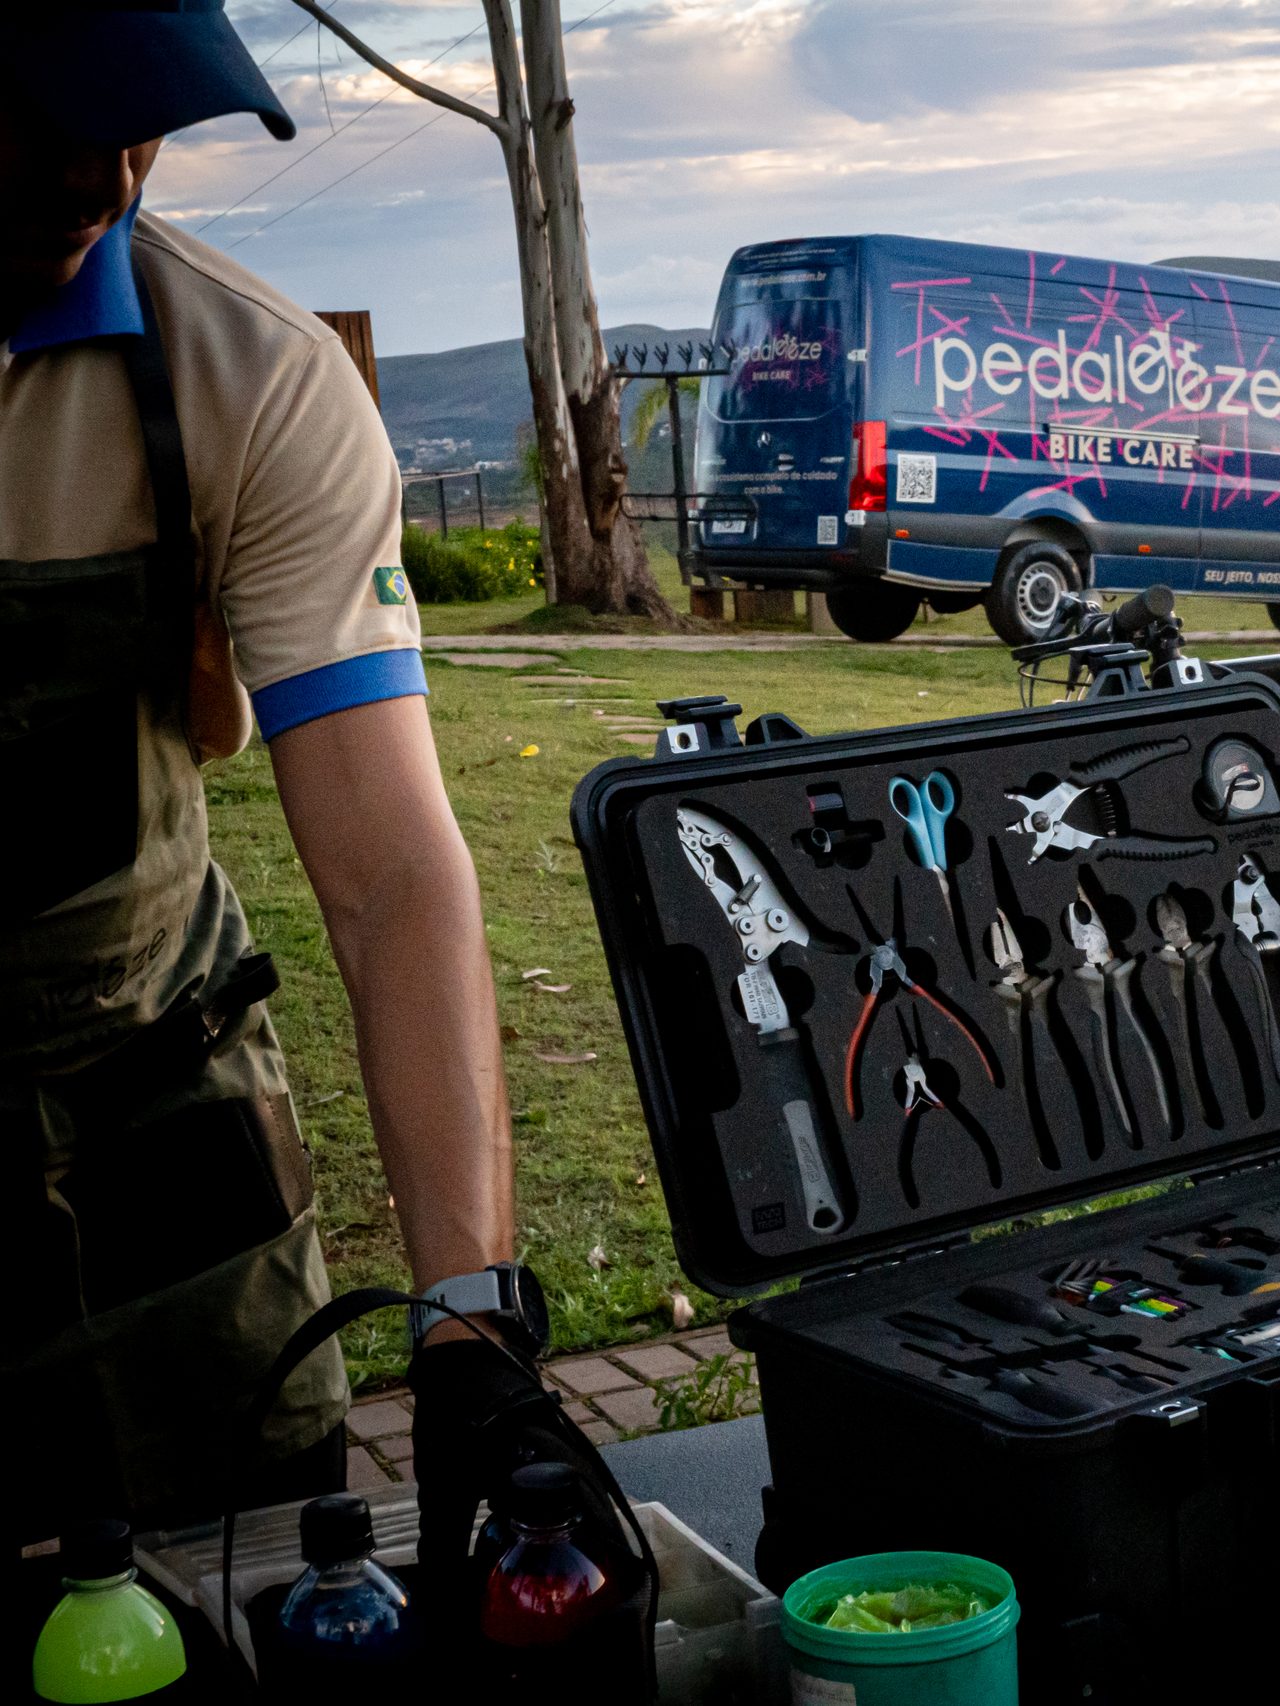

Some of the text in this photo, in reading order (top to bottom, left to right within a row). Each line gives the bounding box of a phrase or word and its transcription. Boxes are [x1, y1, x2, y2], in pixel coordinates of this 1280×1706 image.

[1050, 434, 1194, 469] BIKE CARE
[802, 469, 838, 481] cuidado
[1204, 569, 1224, 582] SEU
[1224, 571, 1255, 585] JEITO,
